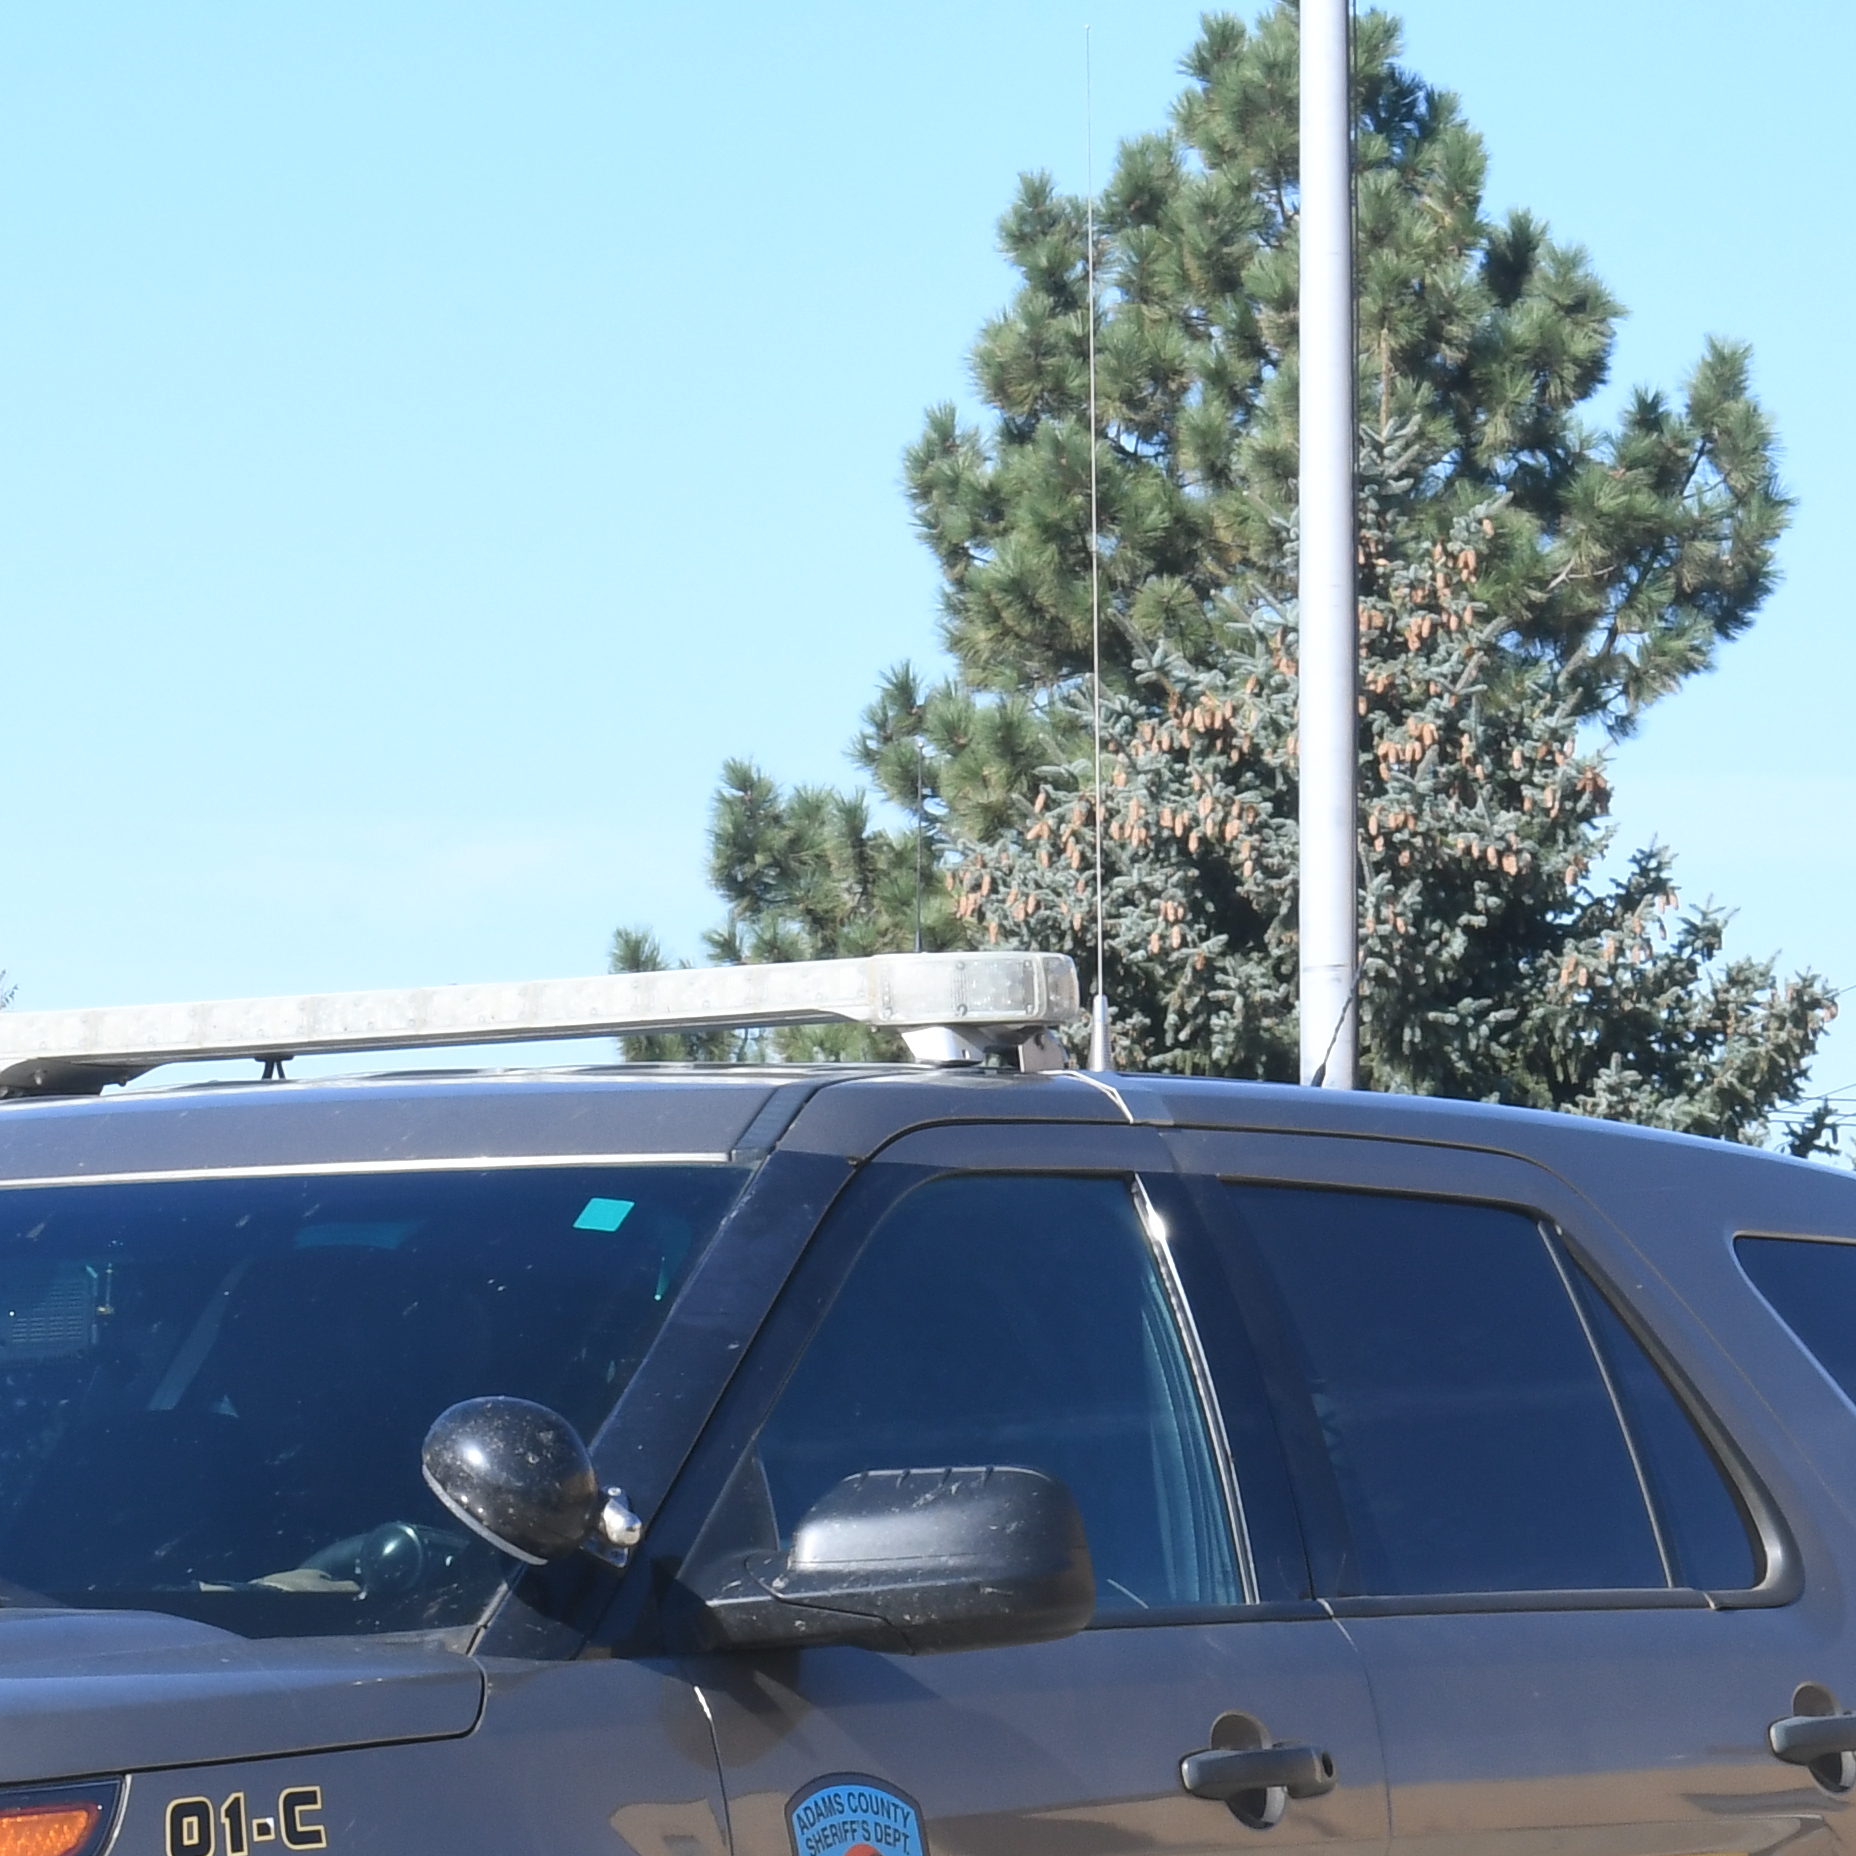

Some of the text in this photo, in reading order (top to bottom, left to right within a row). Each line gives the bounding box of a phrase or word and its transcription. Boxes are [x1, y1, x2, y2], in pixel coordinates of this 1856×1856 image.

[795, 1791, 911, 1836] ADAMS COUNTY
[874, 1820, 910, 1856] DEPT.
